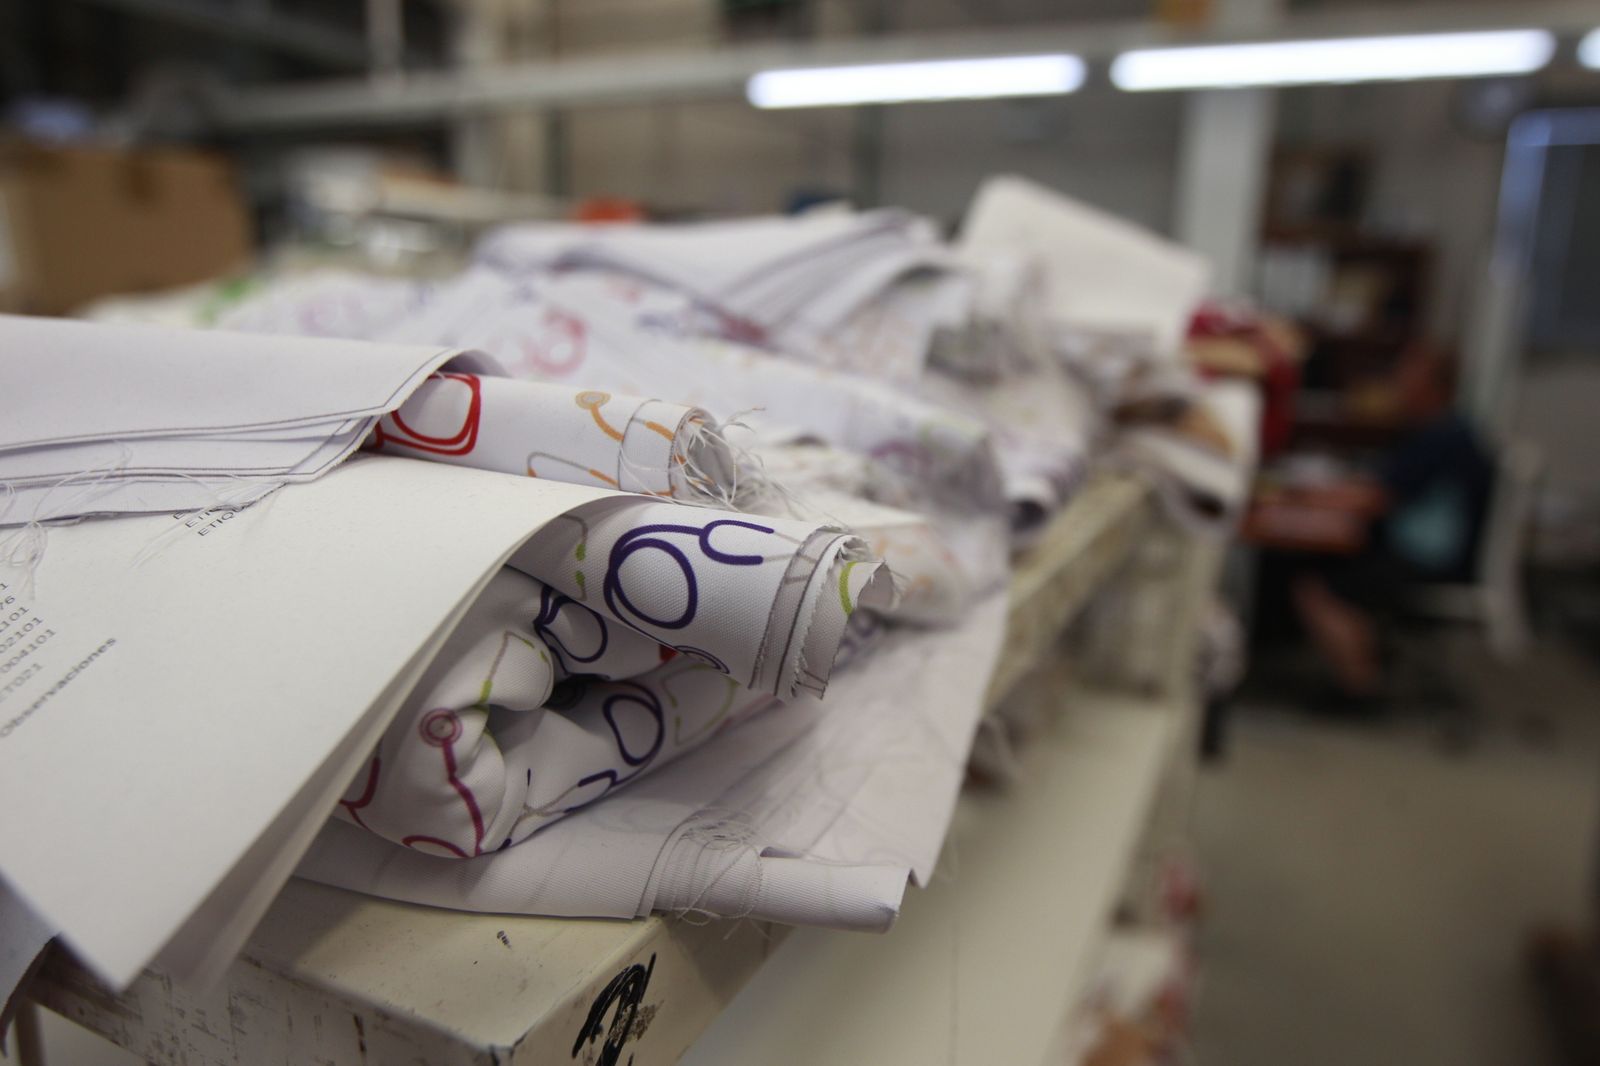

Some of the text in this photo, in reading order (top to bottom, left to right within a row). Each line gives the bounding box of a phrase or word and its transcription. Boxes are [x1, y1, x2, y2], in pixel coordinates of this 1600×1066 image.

[185, 511, 211, 528] ETI
[0, 607, 29, 632] 101
[0, 638, 116, 738] Observaciones
